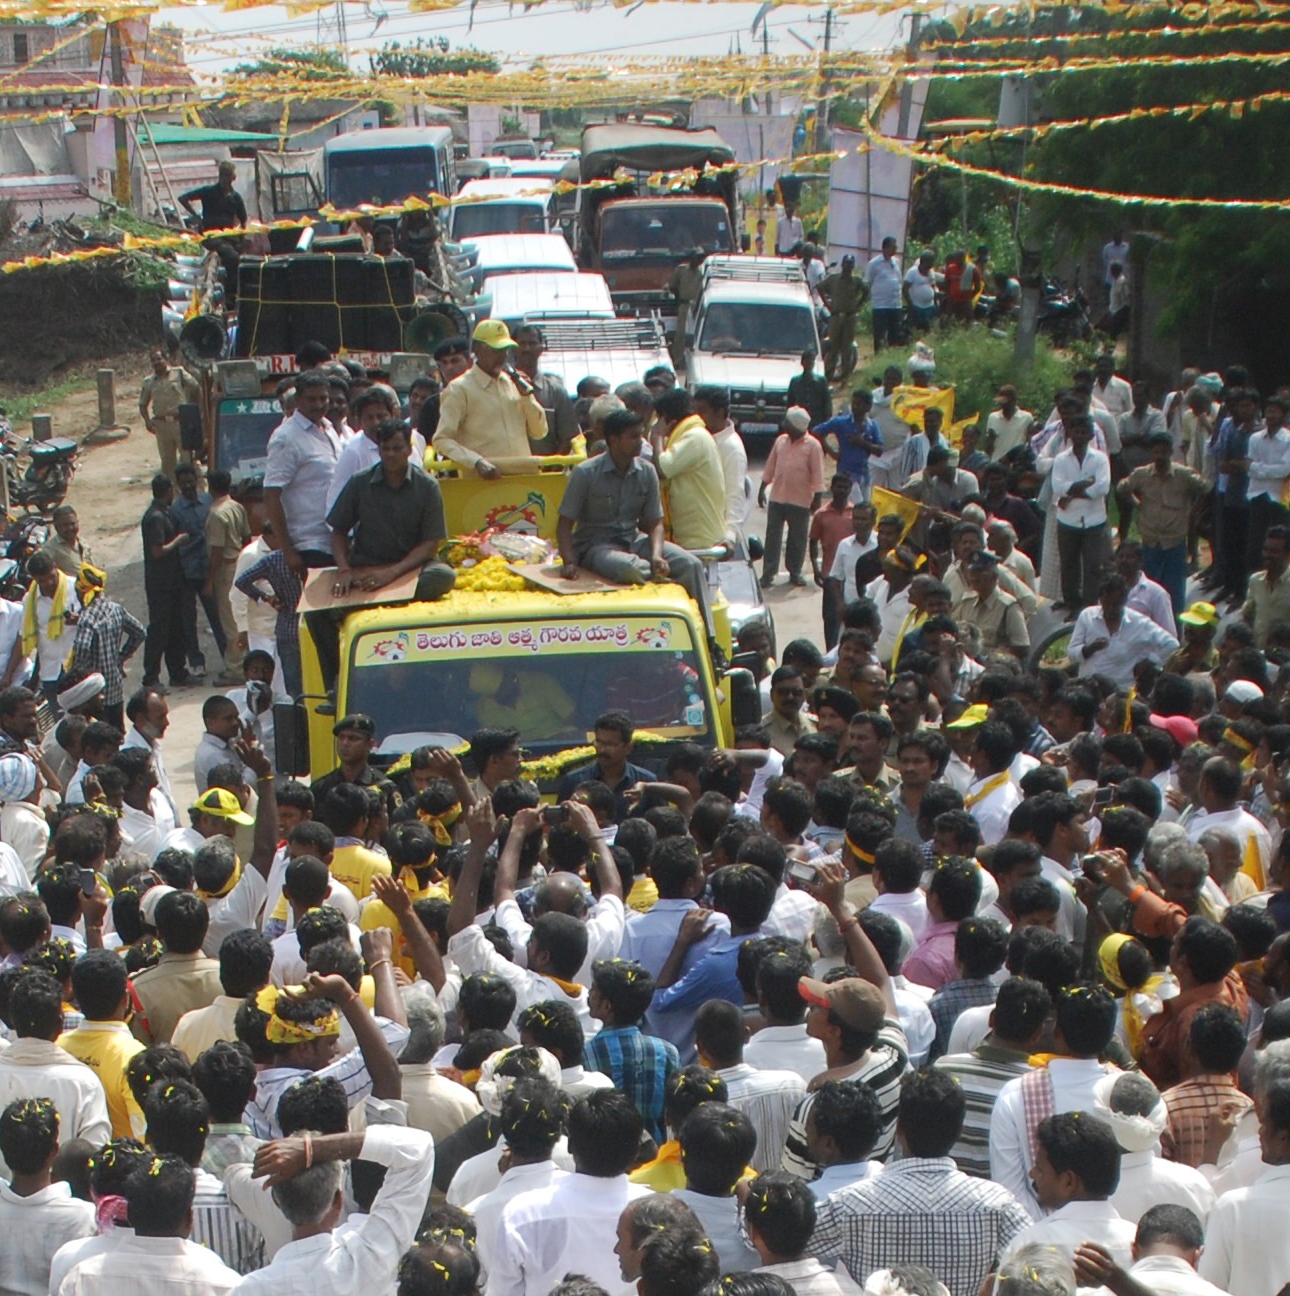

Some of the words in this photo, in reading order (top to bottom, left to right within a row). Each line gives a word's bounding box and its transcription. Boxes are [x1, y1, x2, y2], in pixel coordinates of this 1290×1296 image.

[416, 631, 468, 650] తెలుగు
[471, 631, 502, 647] జాతి
[508, 628, 539, 651] ఆత్మ
[540, 626, 582, 644] గౌరవ
[585, 624, 628, 646] యాత్ర
